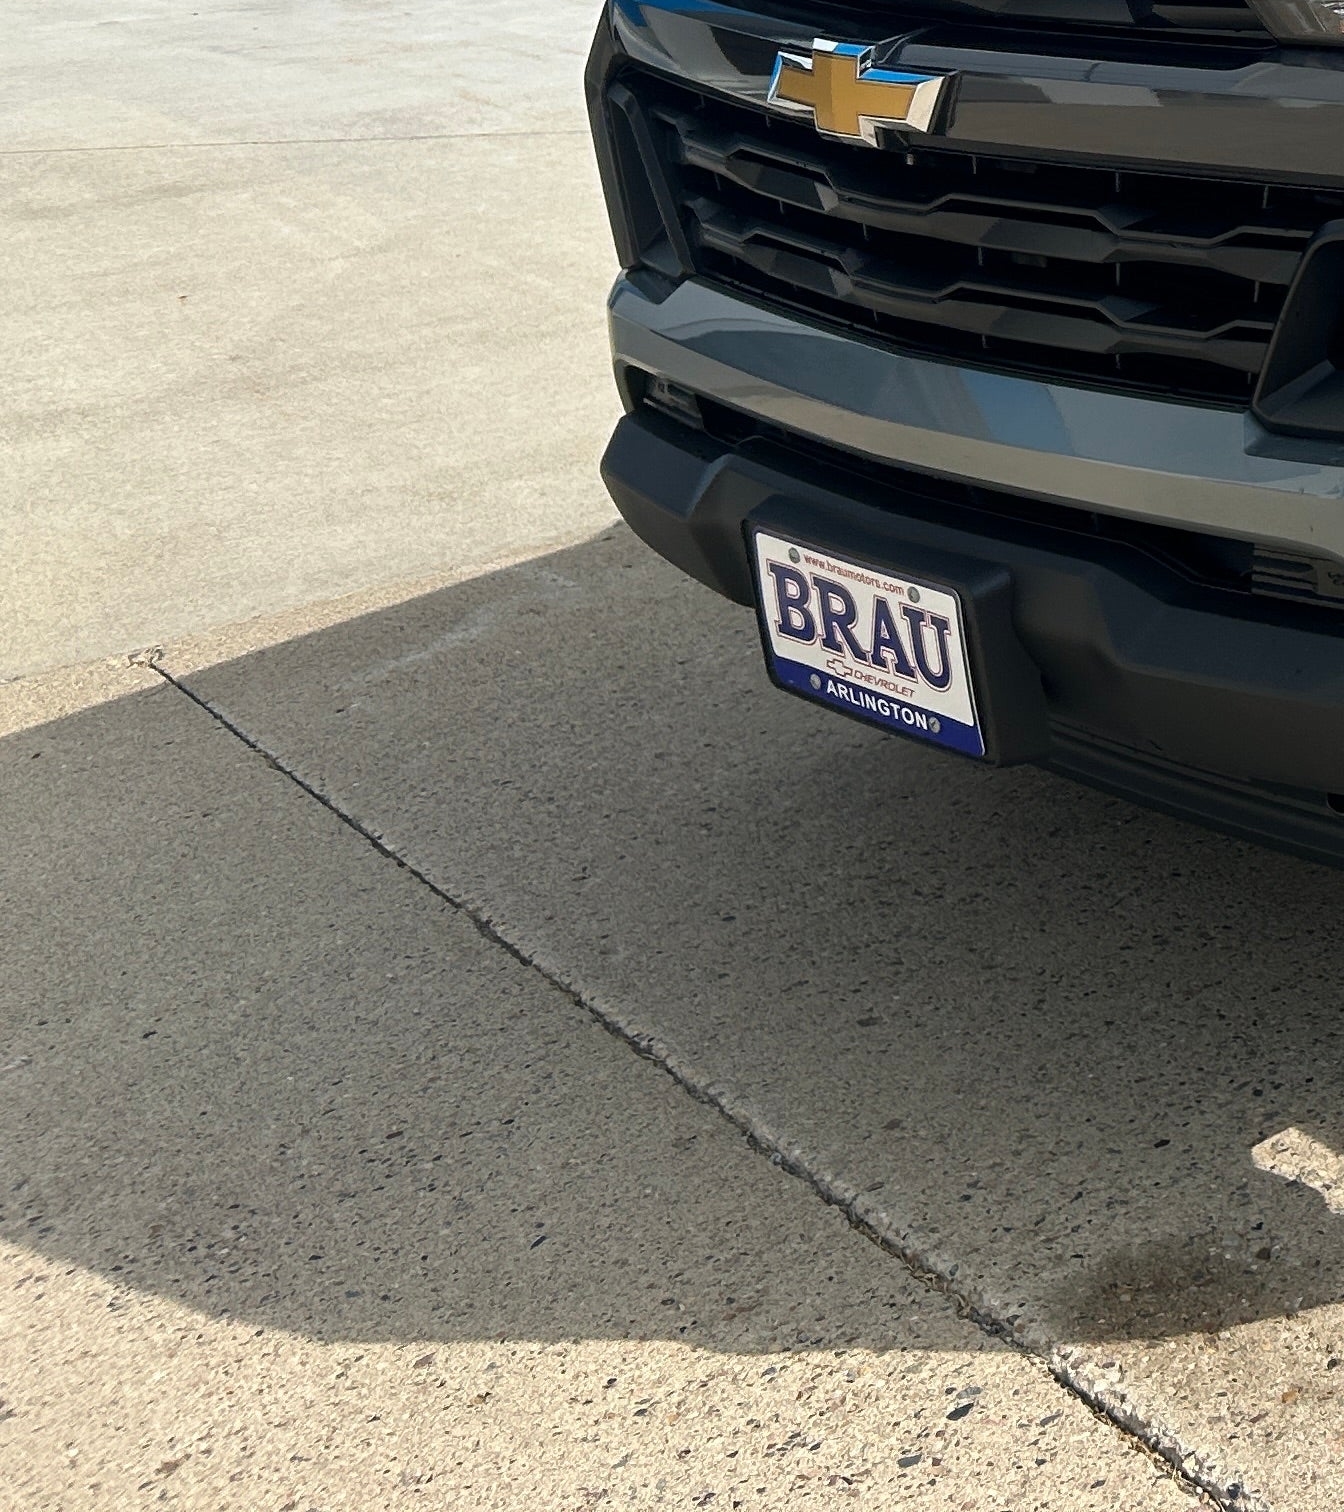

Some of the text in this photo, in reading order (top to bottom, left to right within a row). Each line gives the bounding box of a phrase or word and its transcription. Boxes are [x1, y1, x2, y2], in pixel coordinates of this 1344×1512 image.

[803, 553, 905, 596] www.braumotors.com
[765, 558, 953, 693] BRAU
[826, 680, 928, 730] ARLINGTON
[854, 670, 916, 699] CHEVROLET
